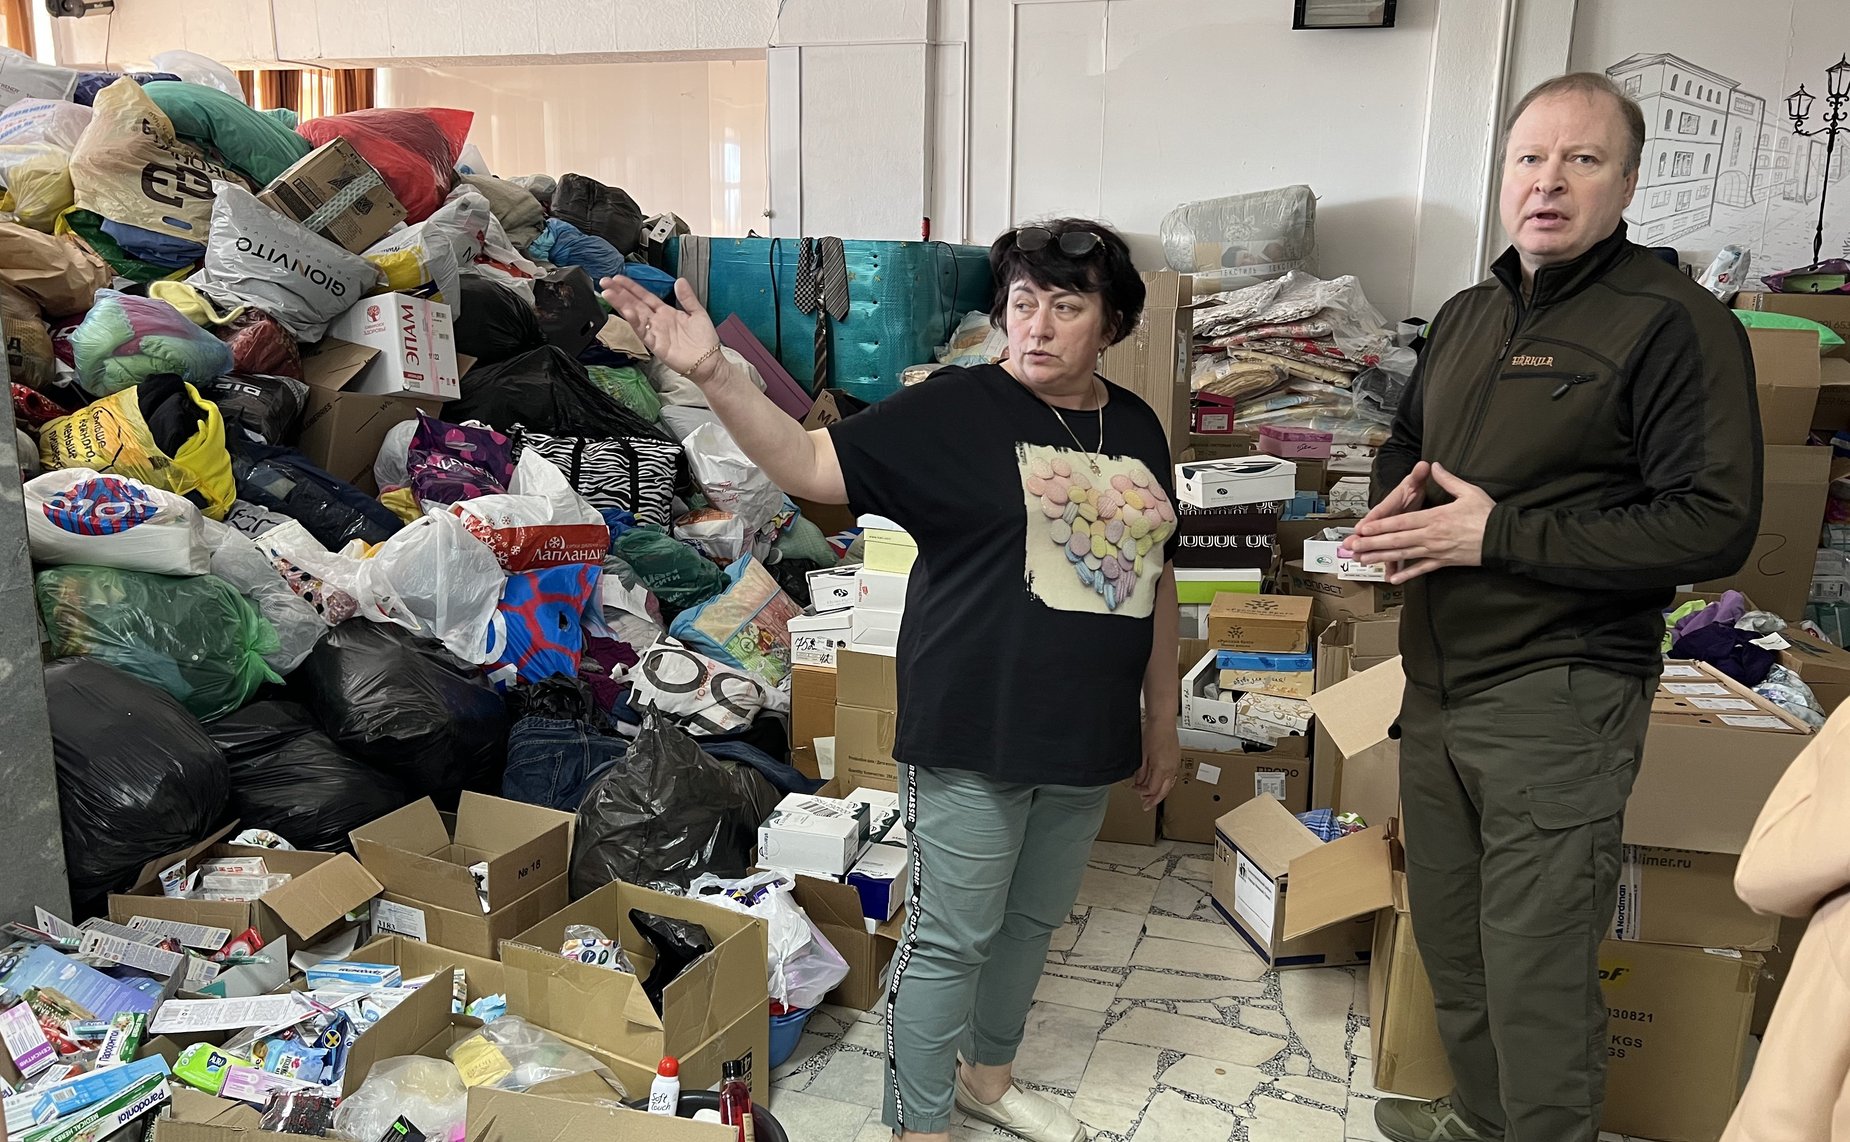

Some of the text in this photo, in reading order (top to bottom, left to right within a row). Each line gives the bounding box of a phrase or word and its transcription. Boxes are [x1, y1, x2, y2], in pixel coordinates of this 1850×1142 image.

[235, 237, 346, 297] GIONVITO
[400, 304, 420, 366] ЭПАМ
[908, 765, 916, 823] BEST CLASSIC
[530, 859, 541, 872] 18
[1616, 885, 1626, 927] Nordman
[377, 919, 396, 930] 3183
[891, 957, 908, 994] CLASSIC
[19, 1045, 52, 1068] СЕНСИТИВ
[886, 1025, 895, 1060] CLASSIC
[1607, 1046, 1626, 1058] GS
[1611, 1035, 1643, 1048] KGS
[117, 1089, 165, 1124] Parodontol
[650, 1102, 671, 1112] Touch
[652, 1092, 668, 1104] Soft
[54, 1112, 100, 1142] MEDICAL HERBS
